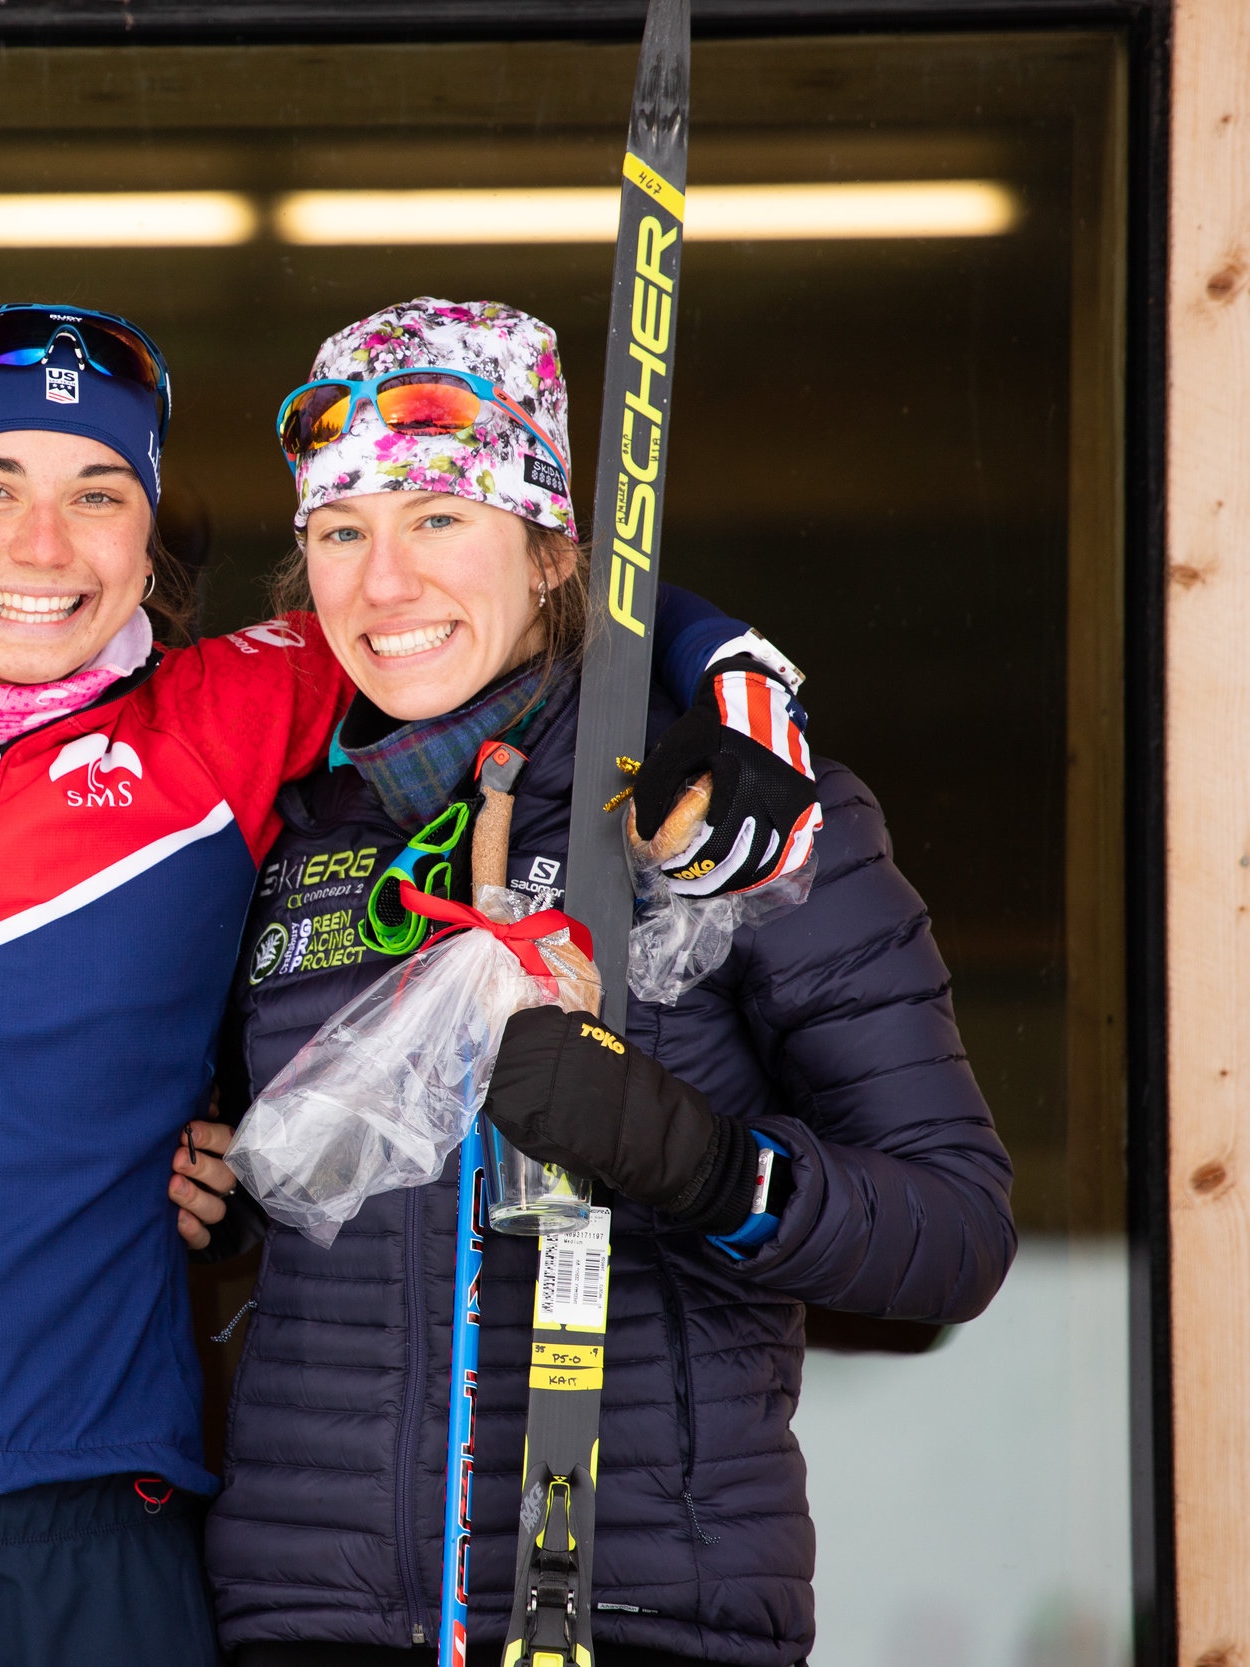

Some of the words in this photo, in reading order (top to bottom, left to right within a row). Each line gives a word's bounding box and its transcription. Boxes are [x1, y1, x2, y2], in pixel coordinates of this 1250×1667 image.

[638, 171, 662, 195] 467
[48, 370, 75, 382] US
[608, 215, 678, 638] FISCHER
[533, 461, 561, 480] SKIDA
[66, 780, 133, 808] SMS
[303, 884, 352, 904] concept
[354, 883, 364, 894] 2
[299, 909, 353, 938] GREEN
[294, 928, 355, 956] RACING
[289, 946, 367, 973] PROJECT
[579, 1022, 626, 1056] TOKO
